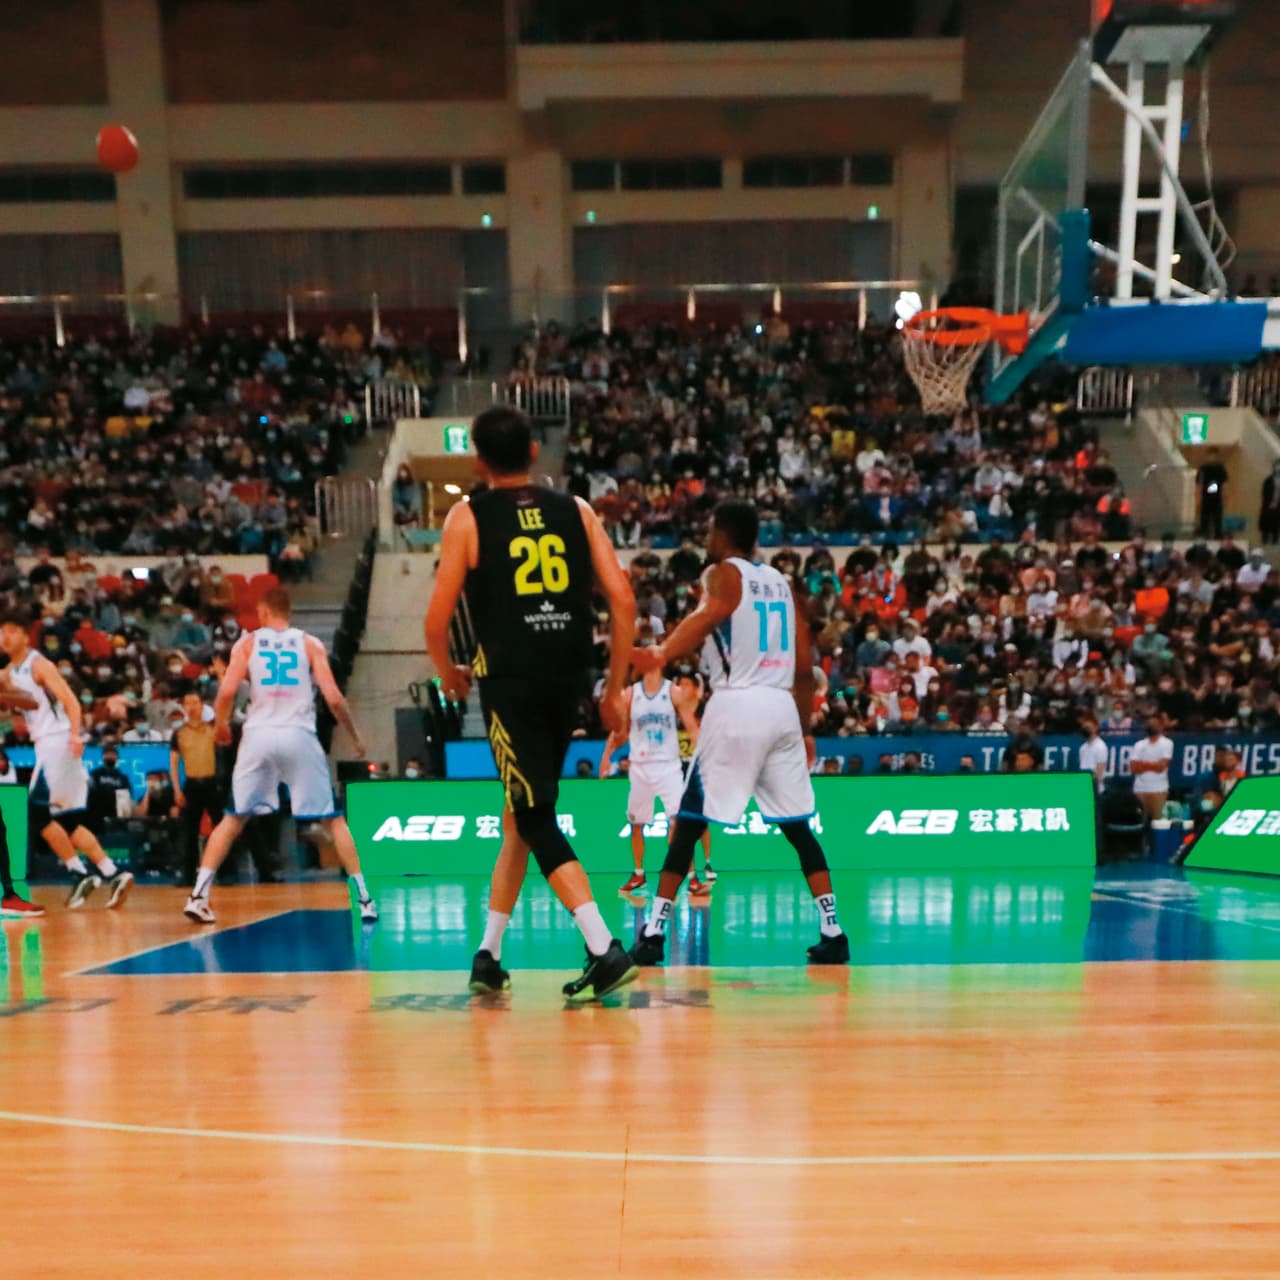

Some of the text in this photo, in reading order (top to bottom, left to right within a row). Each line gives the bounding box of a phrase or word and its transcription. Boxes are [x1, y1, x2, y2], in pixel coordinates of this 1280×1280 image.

[517, 508, 545, 530] LEE
[509, 534, 569, 595] 26
[259, 651, 299, 686] 32
[372, 815, 466, 842] AEB
[866, 807, 1070, 835] AEB 宏碁資訊
[1215, 809, 1267, 836] AEB
